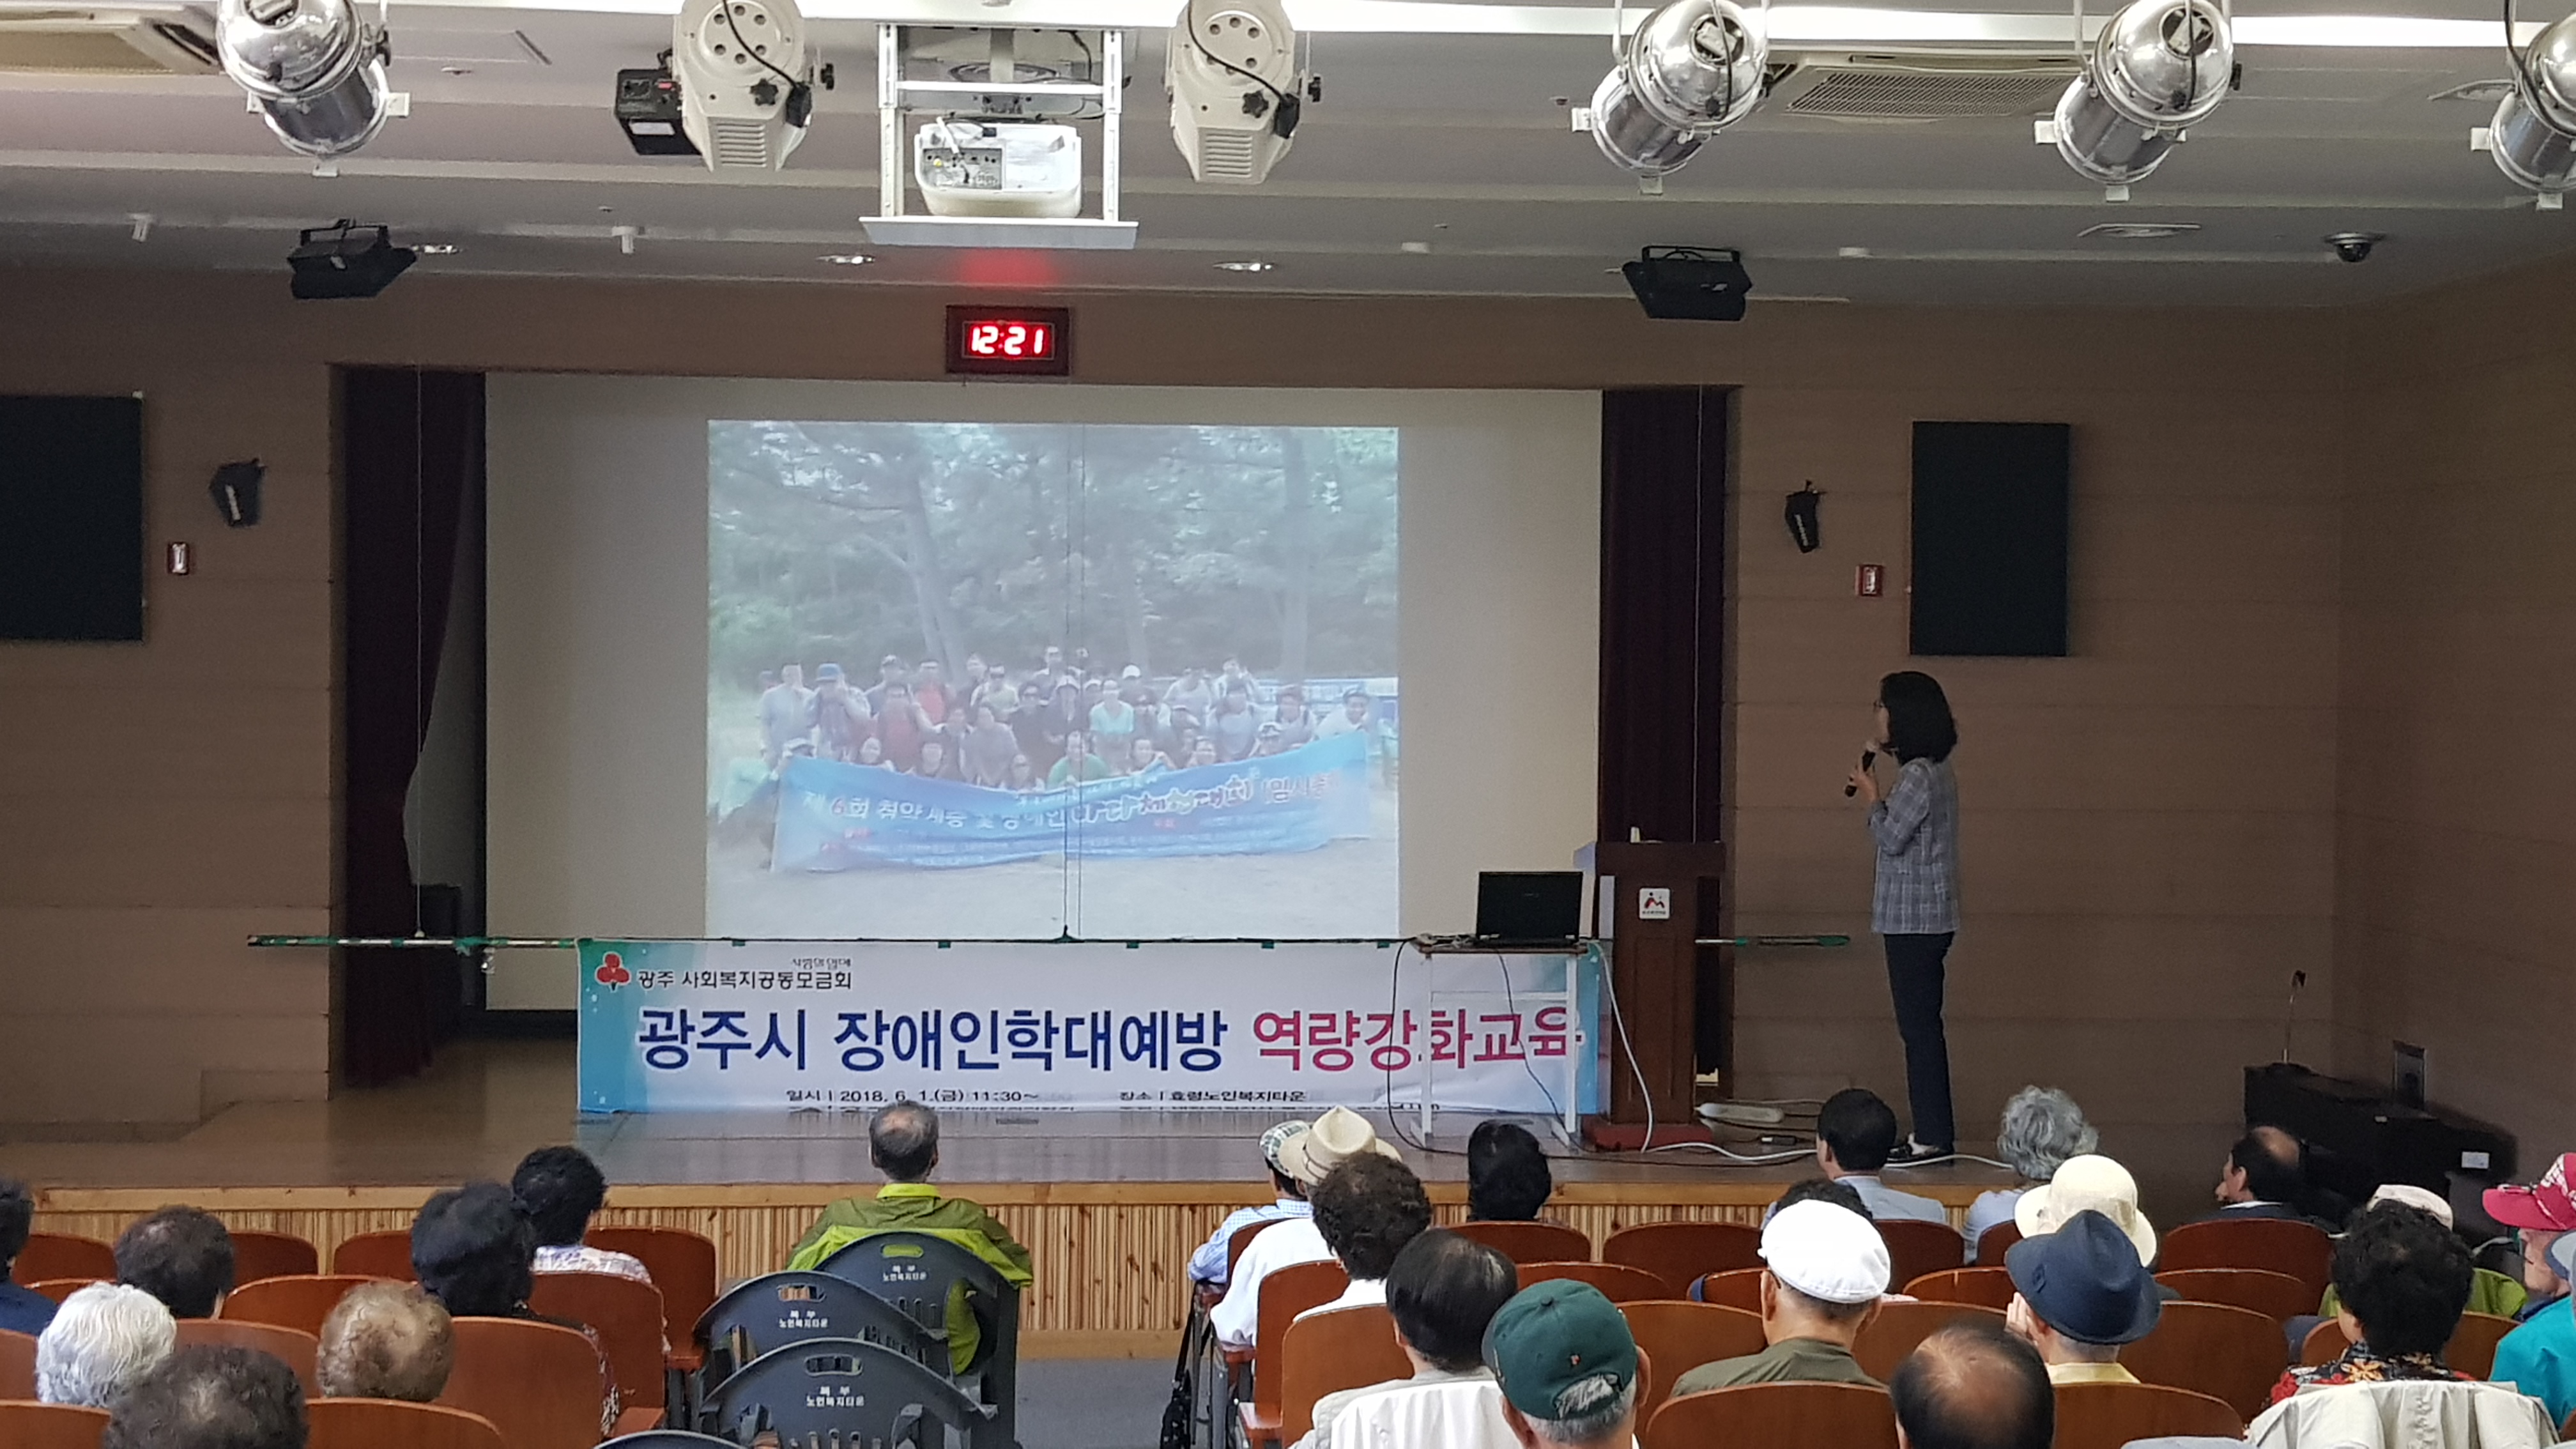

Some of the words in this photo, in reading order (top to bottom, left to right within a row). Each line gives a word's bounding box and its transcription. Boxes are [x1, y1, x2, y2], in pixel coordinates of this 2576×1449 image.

[971, 326, 1044, 355] 12:21
[639, 970, 674, 989] 광주
[682, 970, 851, 990] 사회복지공동모금회
[640, 1008, 806, 1071] 광주시
[834, 1009, 1228, 1071] 장애인학대예방
[1253, 1007, 1583, 1071] 역량강화교육
[786, 1089, 821, 1102] 일시
[840, 1090, 888, 1103] 2018.
[973, 1091, 1039, 1102] 11:30~
[1119, 1091, 1153, 1101] 장소
[1169, 1090, 1307, 1102] 효령노인복지타운
